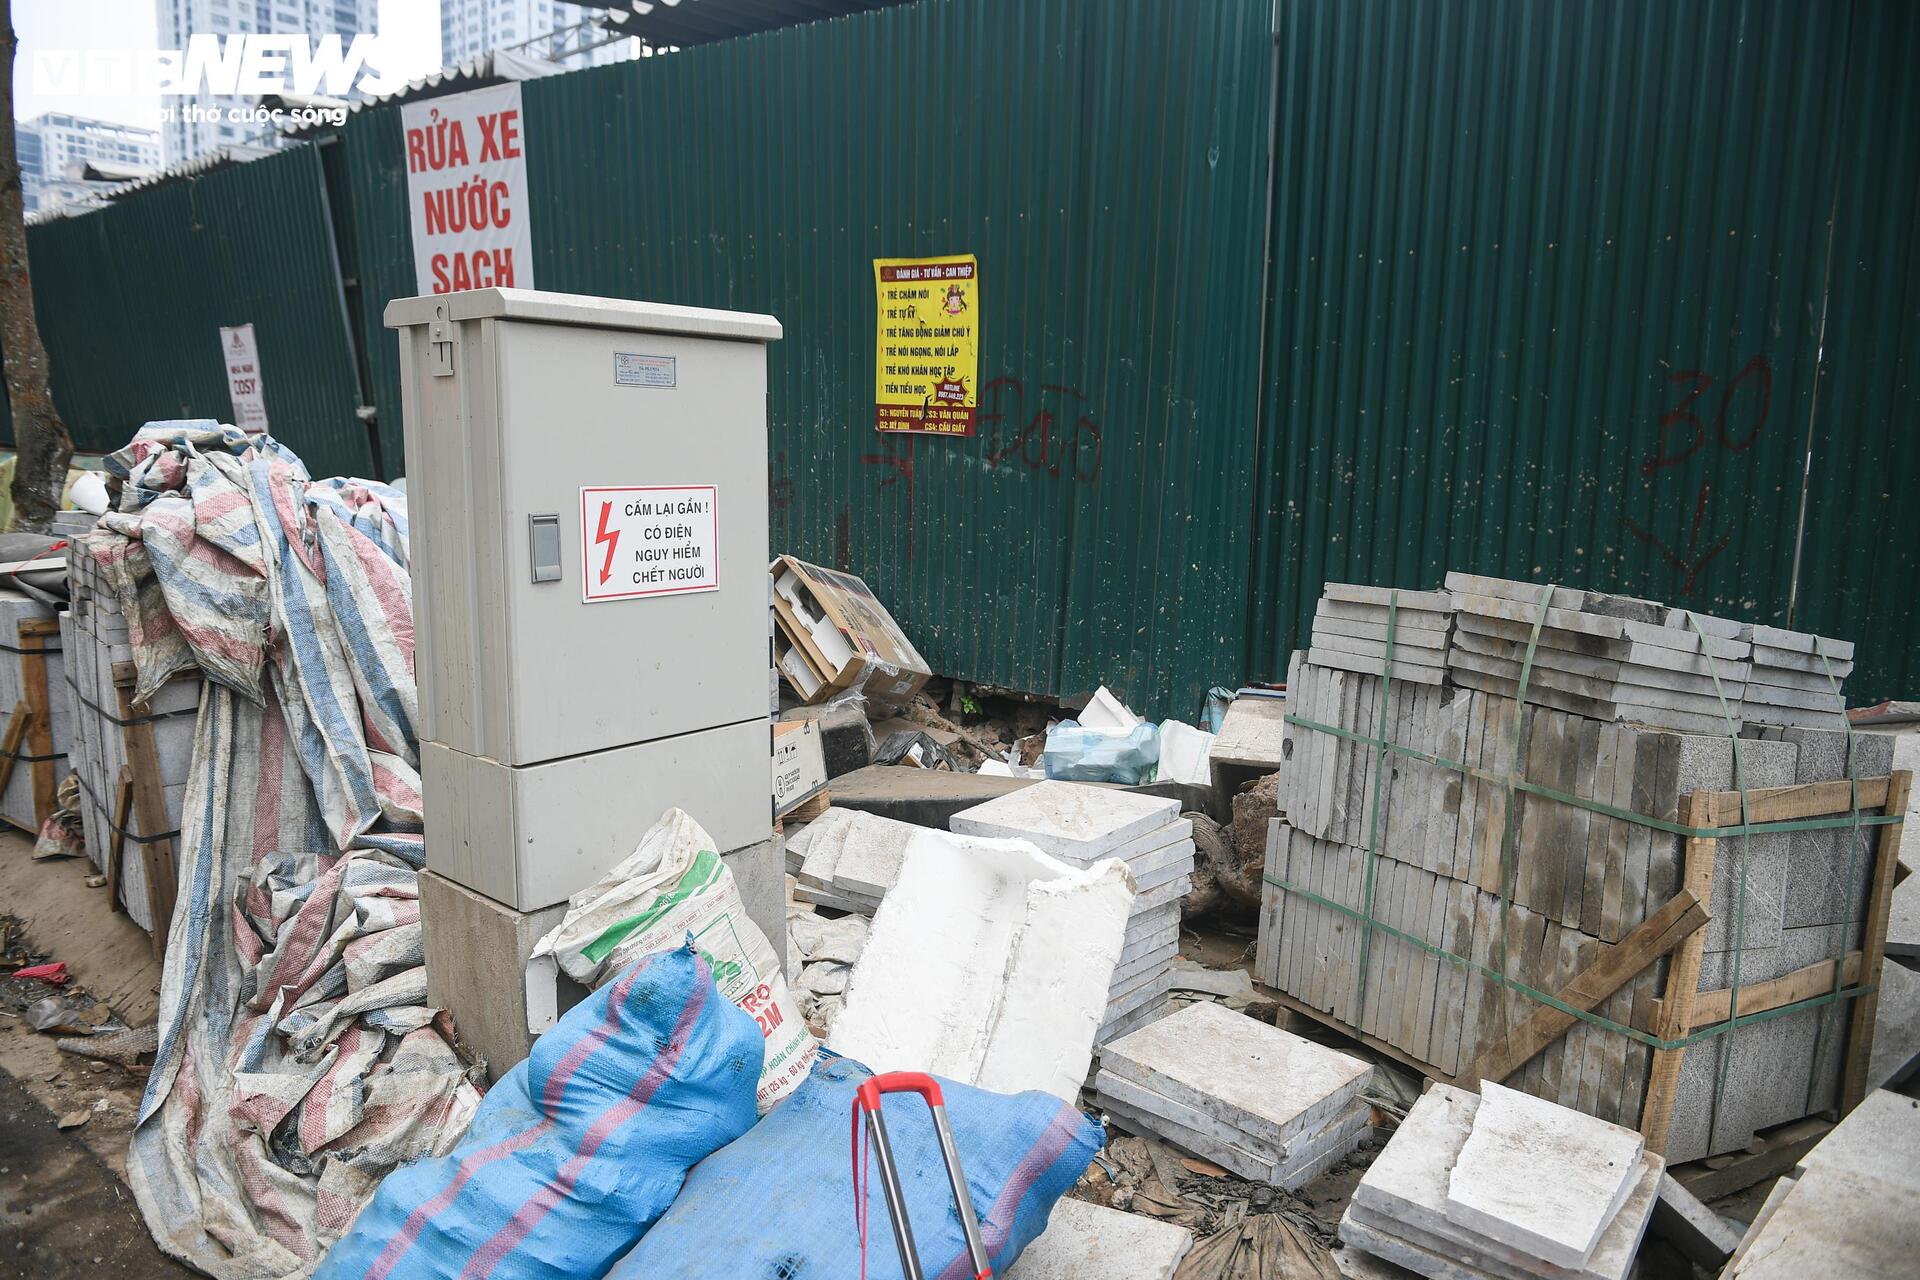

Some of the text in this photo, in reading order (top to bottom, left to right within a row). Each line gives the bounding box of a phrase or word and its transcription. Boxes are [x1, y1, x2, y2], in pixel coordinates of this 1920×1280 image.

[407, 108, 520, 173] RỬA XE
[424, 174, 511, 235] NƯỚC
[946, 267, 956, 277] CAN
[888, 288, 929, 302] TRẺ CHẬM NÓI
[887, 307, 897, 318] TRẺ
[887, 327, 897, 337] TRẺ
[966, 326, 970, 337] Ý
[886, 347, 897, 357] TRẺ
[898, 347, 909, 356] NÓI
[935, 347, 945, 356] NÓI
[886, 364, 896, 375] TRẺ
[898, 365, 910, 375] KHÓ
[929, 367, 942, 377] HỌC
[234, 379, 255, 395] COSY
[1639, 354, 1773, 476] 30
[625, 497, 652, 517] CẤM
[656, 502, 674, 518] LẠI
[677, 495, 702, 515] GẦN
[644, 524, 692, 540] CÓ ĐIỆN
[635, 540, 701, 562] NGUY HIỂM
[633, 565, 705, 585] CHẾT NGƯỜI
[768, 1050, 787, 1070] HOÀN
[788, 1065, 798, 1076] 60
